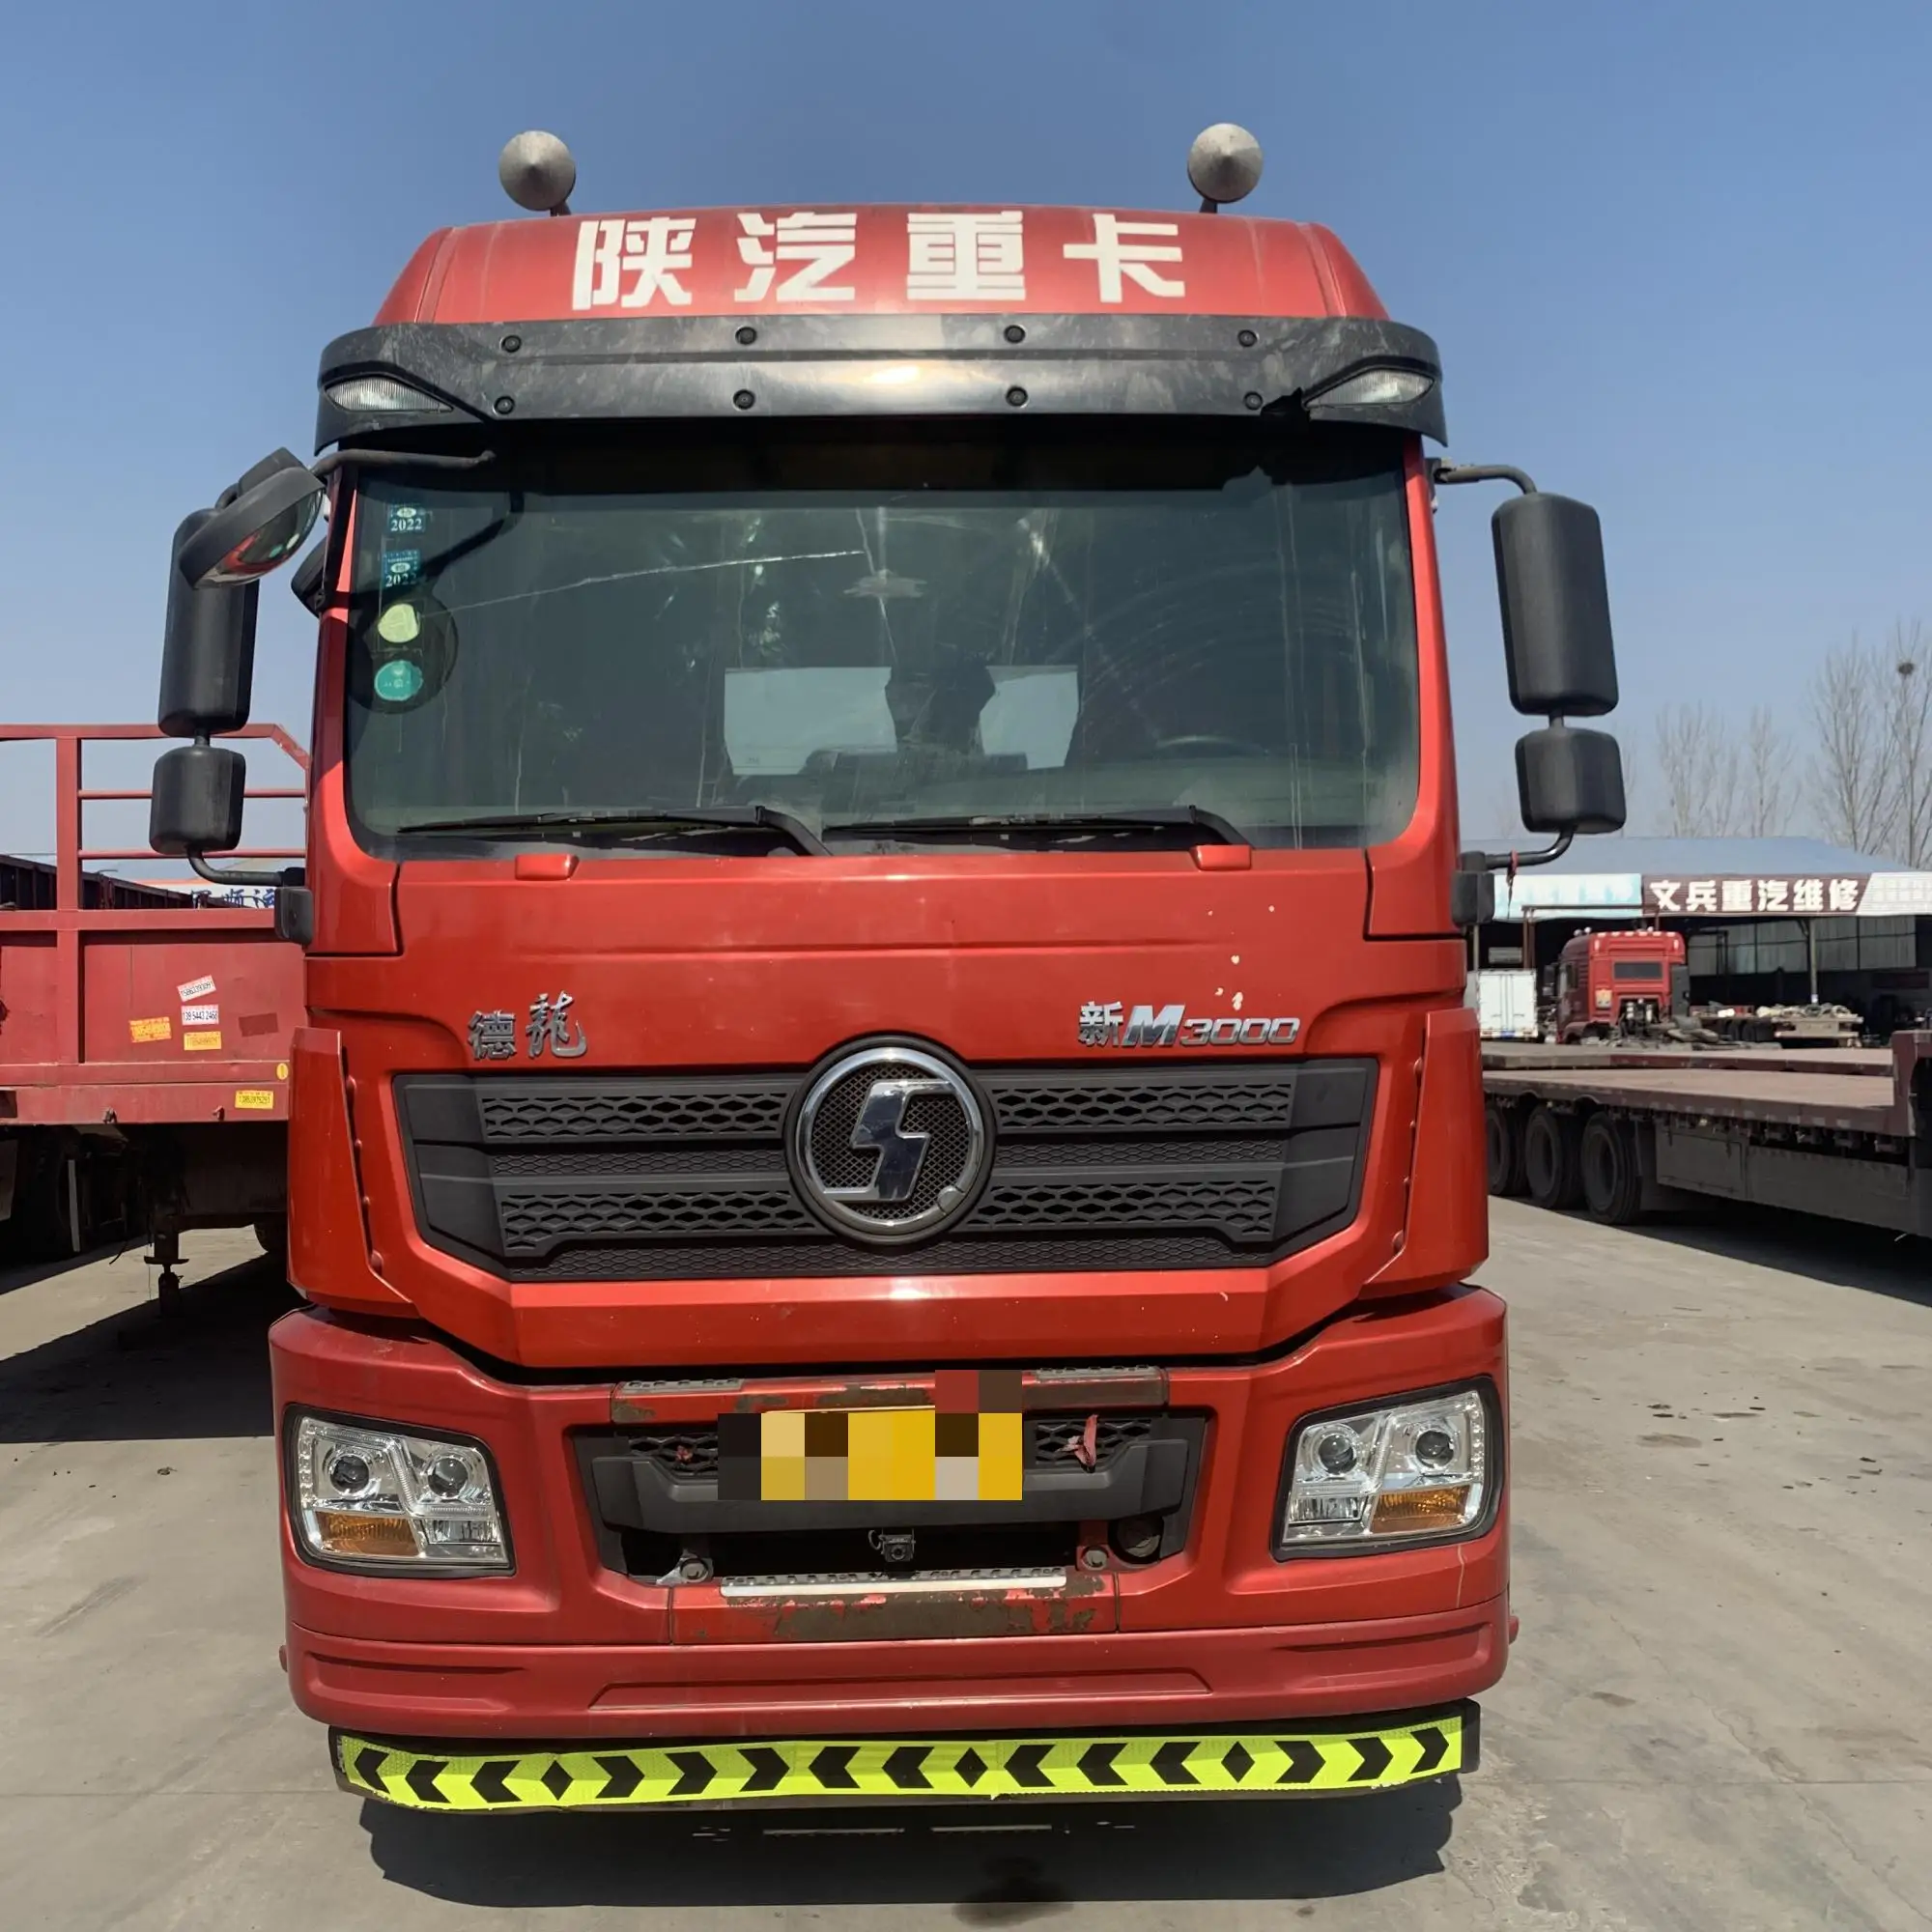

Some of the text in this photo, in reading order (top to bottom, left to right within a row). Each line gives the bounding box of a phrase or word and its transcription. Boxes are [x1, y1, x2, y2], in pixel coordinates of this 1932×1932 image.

[572, 211, 1185, 310] 陕汽重卡
[390, 518, 423, 531] 2022
[1649, 879, 1859, 912] 文兵重汽维修
